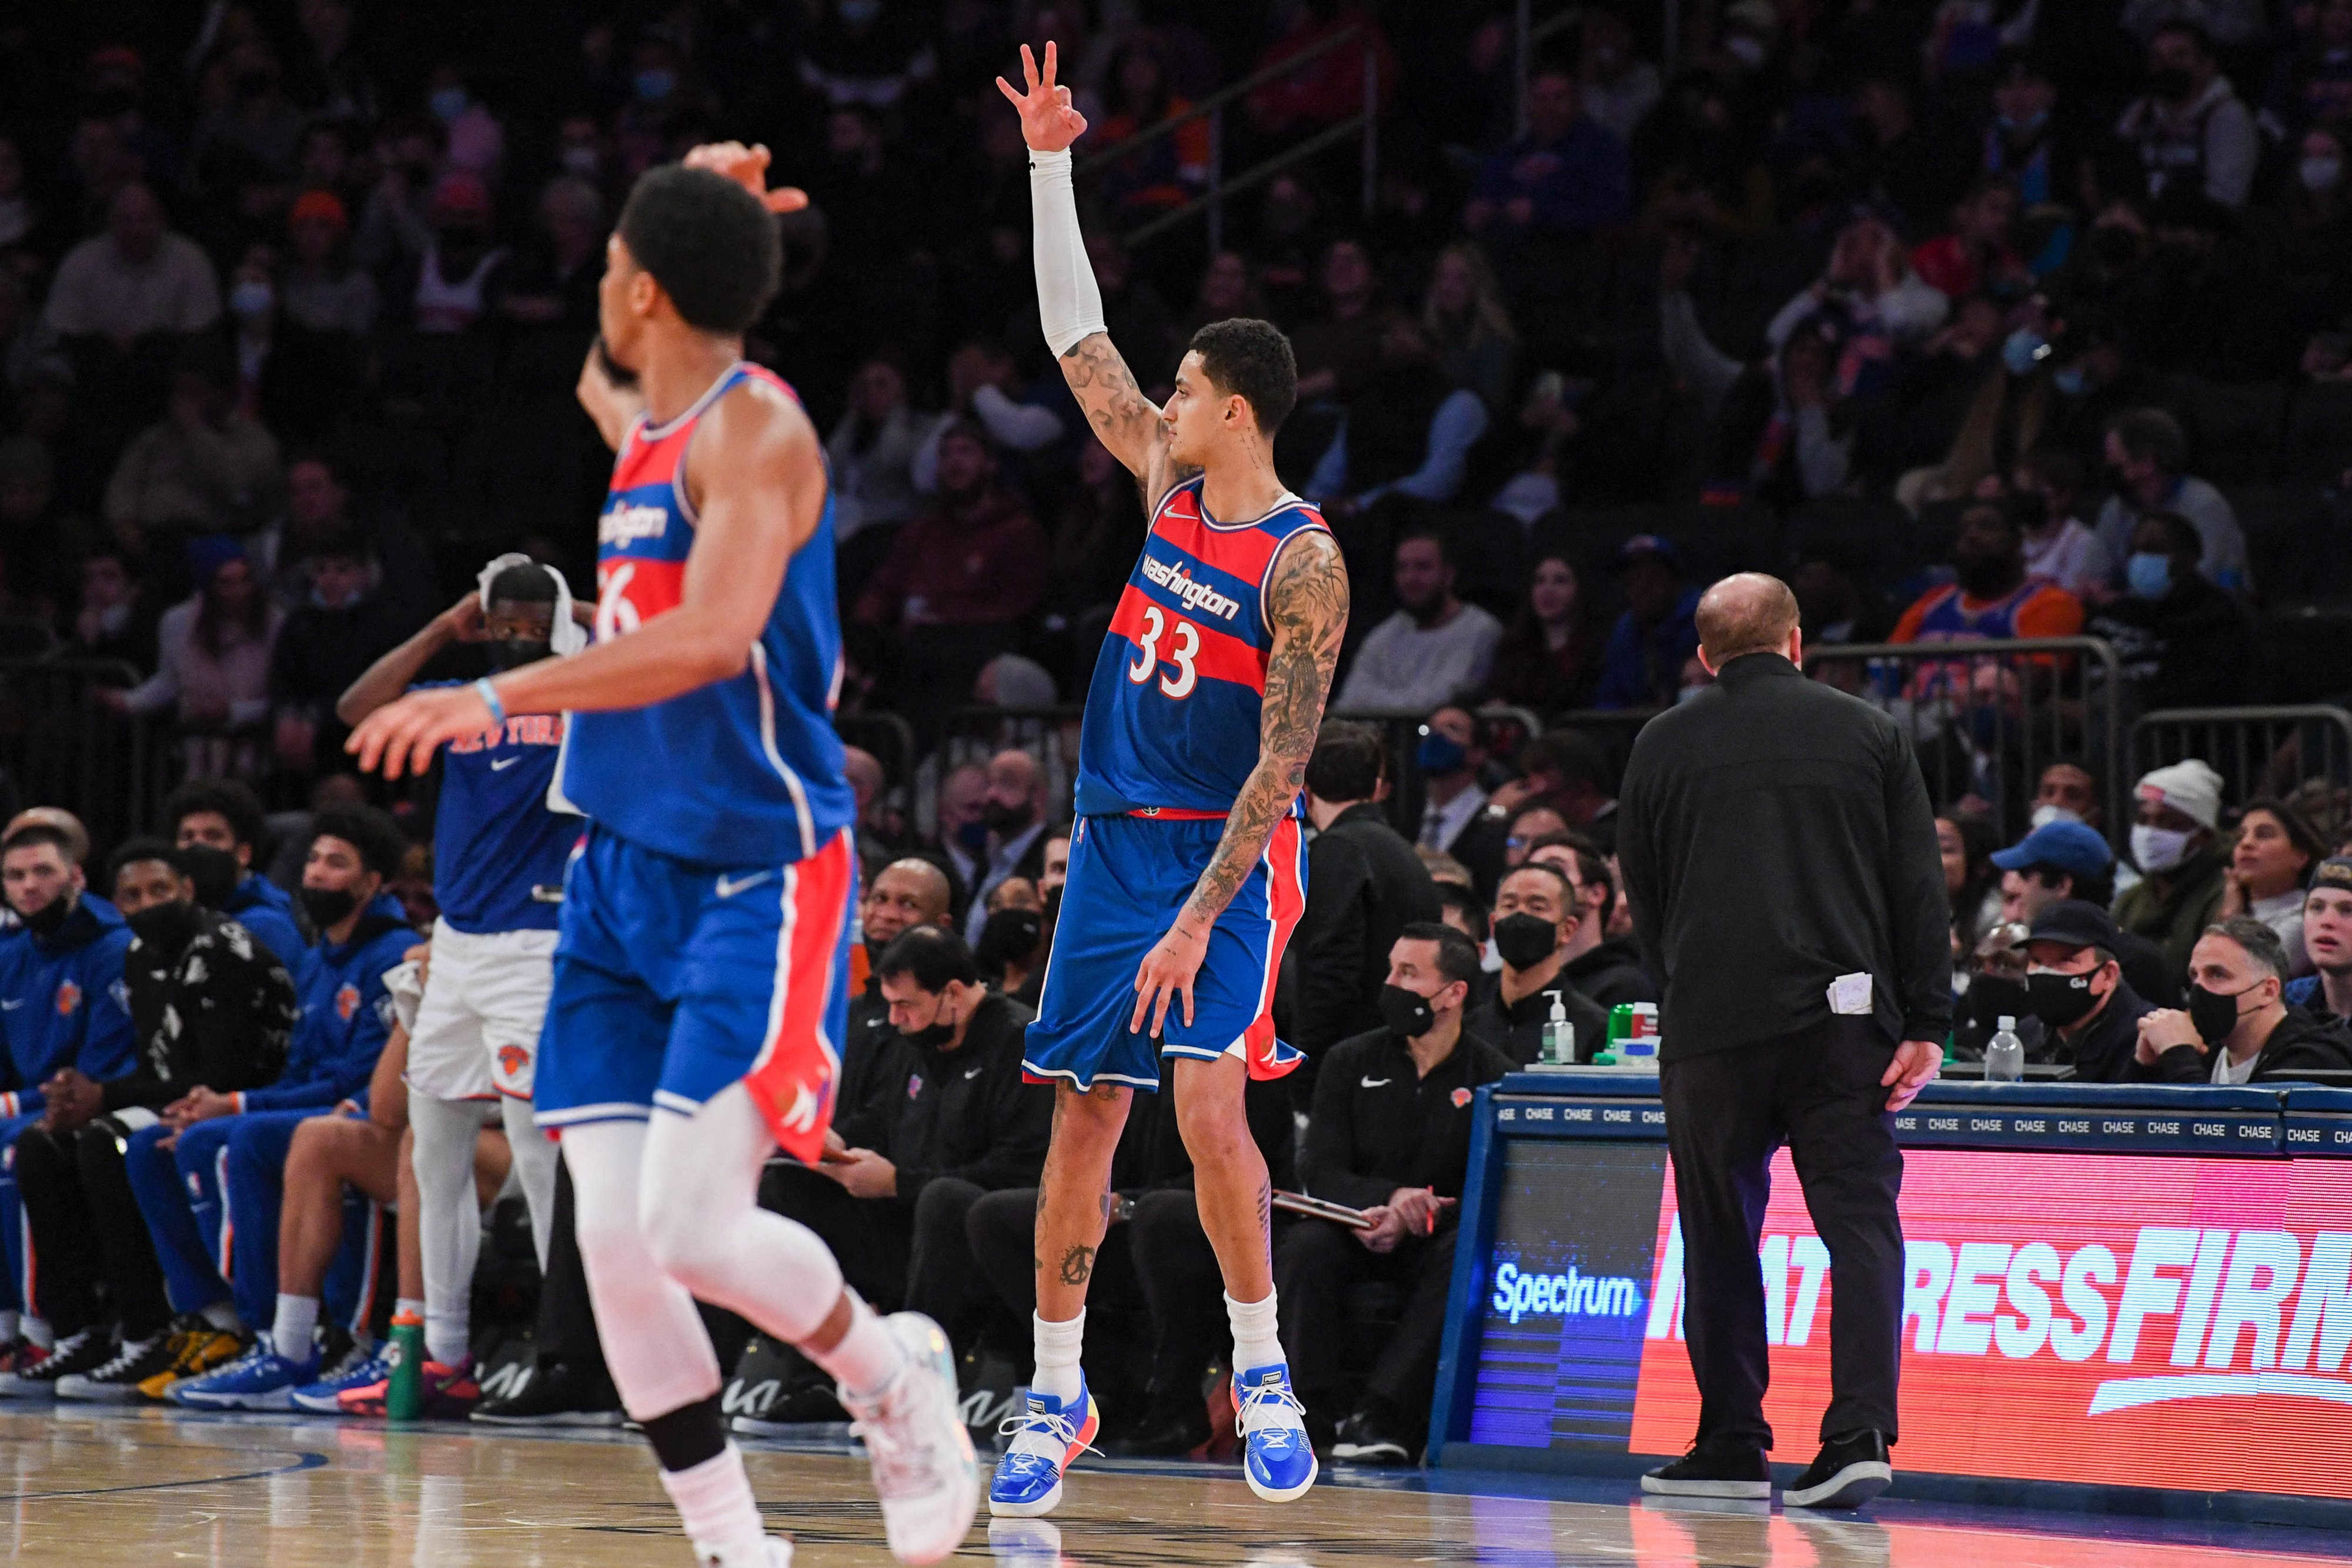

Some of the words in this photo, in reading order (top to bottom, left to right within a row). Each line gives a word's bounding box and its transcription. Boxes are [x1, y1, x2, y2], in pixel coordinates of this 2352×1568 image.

[596, 561, 641, 644] 6
[1128, 605, 1201, 700] 33
[1498, 1108, 1516, 1121] ASE
[1525, 1108, 1553, 1120] CHASE
[1564, 1108, 1593, 1121] CHASE
[1603, 1109, 1632, 1122] CHASE
[1642, 1111, 1666, 1124] CHAS
[1895, 1118, 1916, 1129] HASE
[1929, 1118, 1959, 1131] CHASE
[1971, 1119, 2002, 1131] CHASE
[2014, 1119, 2046, 1132] CHASE
[2059, 1121, 2090, 1133] CHASE
[2103, 1121, 2134, 1134] CHASE
[2147, 1122, 2180, 1135] CHASE
[2193, 1123, 2225, 1136] CHASE
[2239, 1125, 2271, 1139] CHASE
[2287, 1129, 2320, 1142] CHASE
[2334, 1131, 2352, 1144] CHA
[1493, 1262, 1635, 1324] Spectrum
